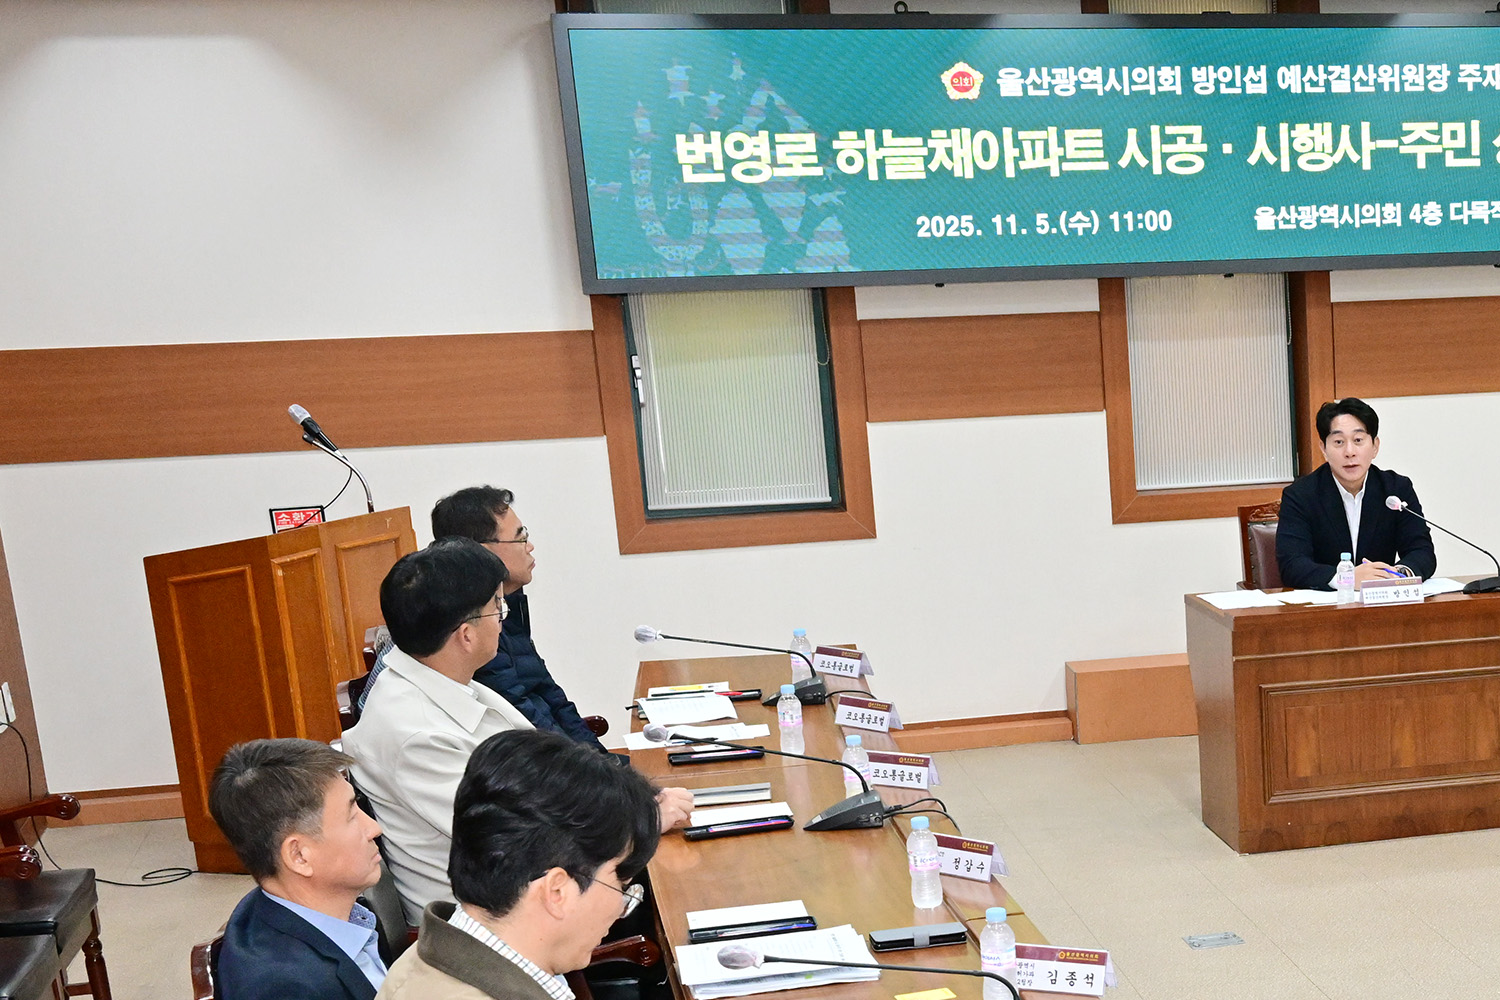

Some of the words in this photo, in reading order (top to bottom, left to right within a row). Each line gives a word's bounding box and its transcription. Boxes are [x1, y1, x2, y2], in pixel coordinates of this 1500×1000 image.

[997, 66, 1182, 96] 울산광역시의회
[1191, 65, 1267, 94] 방인섭
[1278, 64, 1450, 93] 예산결산위원장
[676, 131, 823, 183] 번영로
[833, 127, 1109, 180] 하늘채아파트
[1118, 124, 1208, 175] 시공
[1247, 119, 1481, 172] 시행사-주민
[917, 214, 982, 237] 2025.
[992, 214, 1027, 235] 11.
[1110, 210, 1172, 232] 11:00
[1255, 204, 1402, 230] 울산광역시의회
[1410, 202, 1443, 226] 4층
[278, 511, 319, 522] 소화기
[873, 768, 922, 783] 코오롱글로벌
